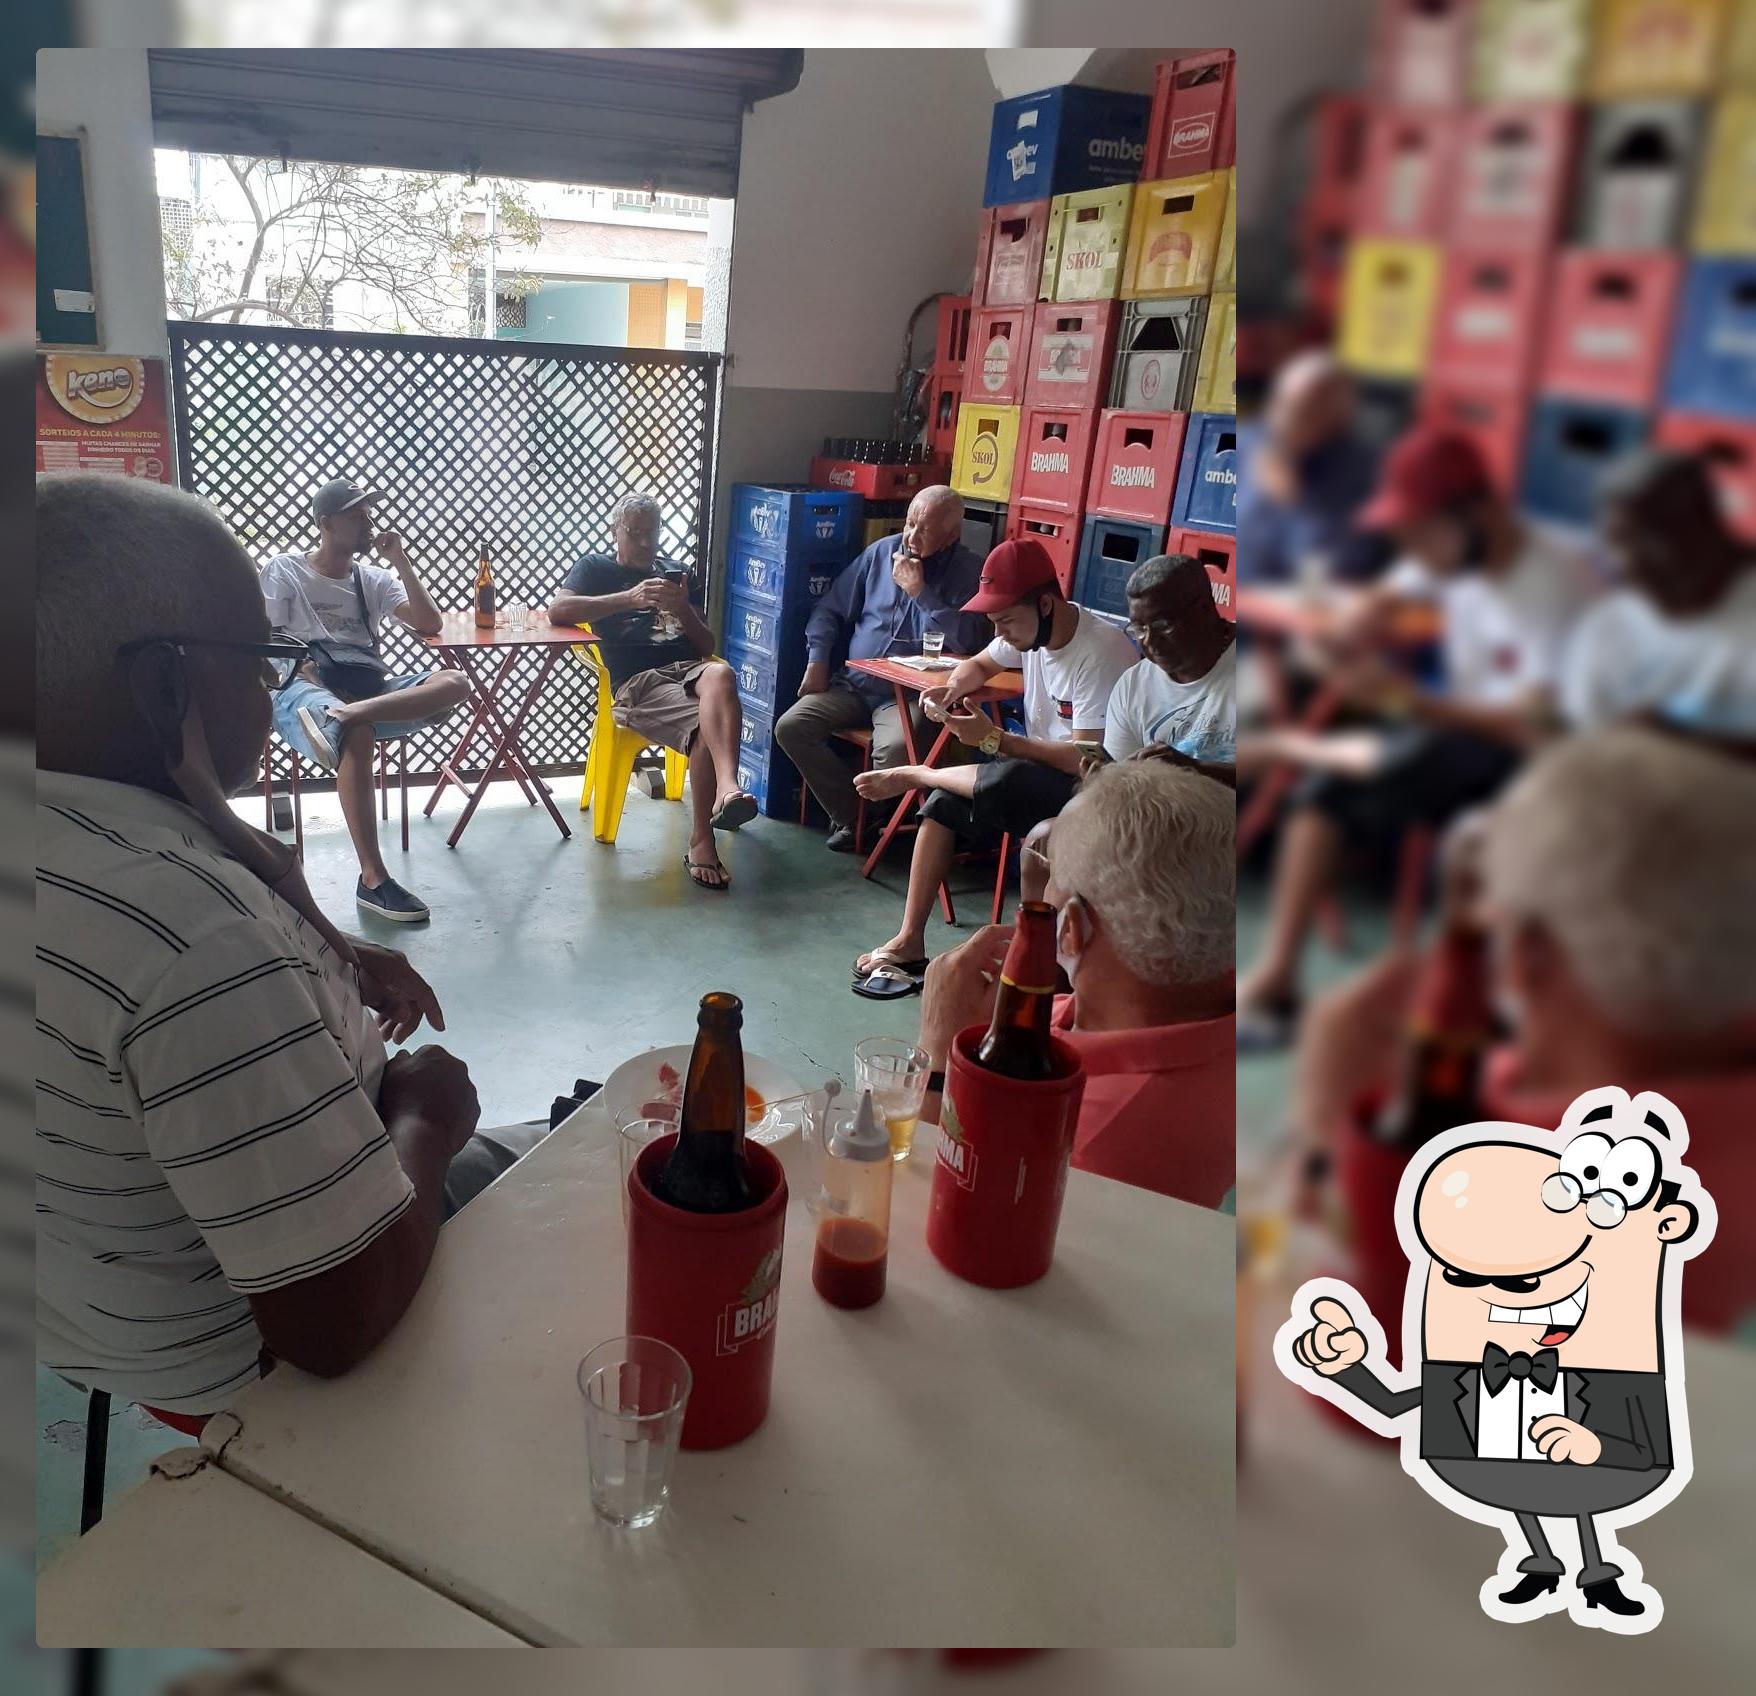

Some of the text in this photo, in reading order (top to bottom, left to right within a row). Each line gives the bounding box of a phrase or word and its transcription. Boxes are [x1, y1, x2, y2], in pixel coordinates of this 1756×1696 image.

[1066, 251, 1104, 270] SKOL
[39, 428, 82, 437] SORTEIOS
[971, 451, 995, 466] SKOL
[1031, 451, 1069, 474] BRAHMA
[1111, 463, 1155, 489] BRAHMA
